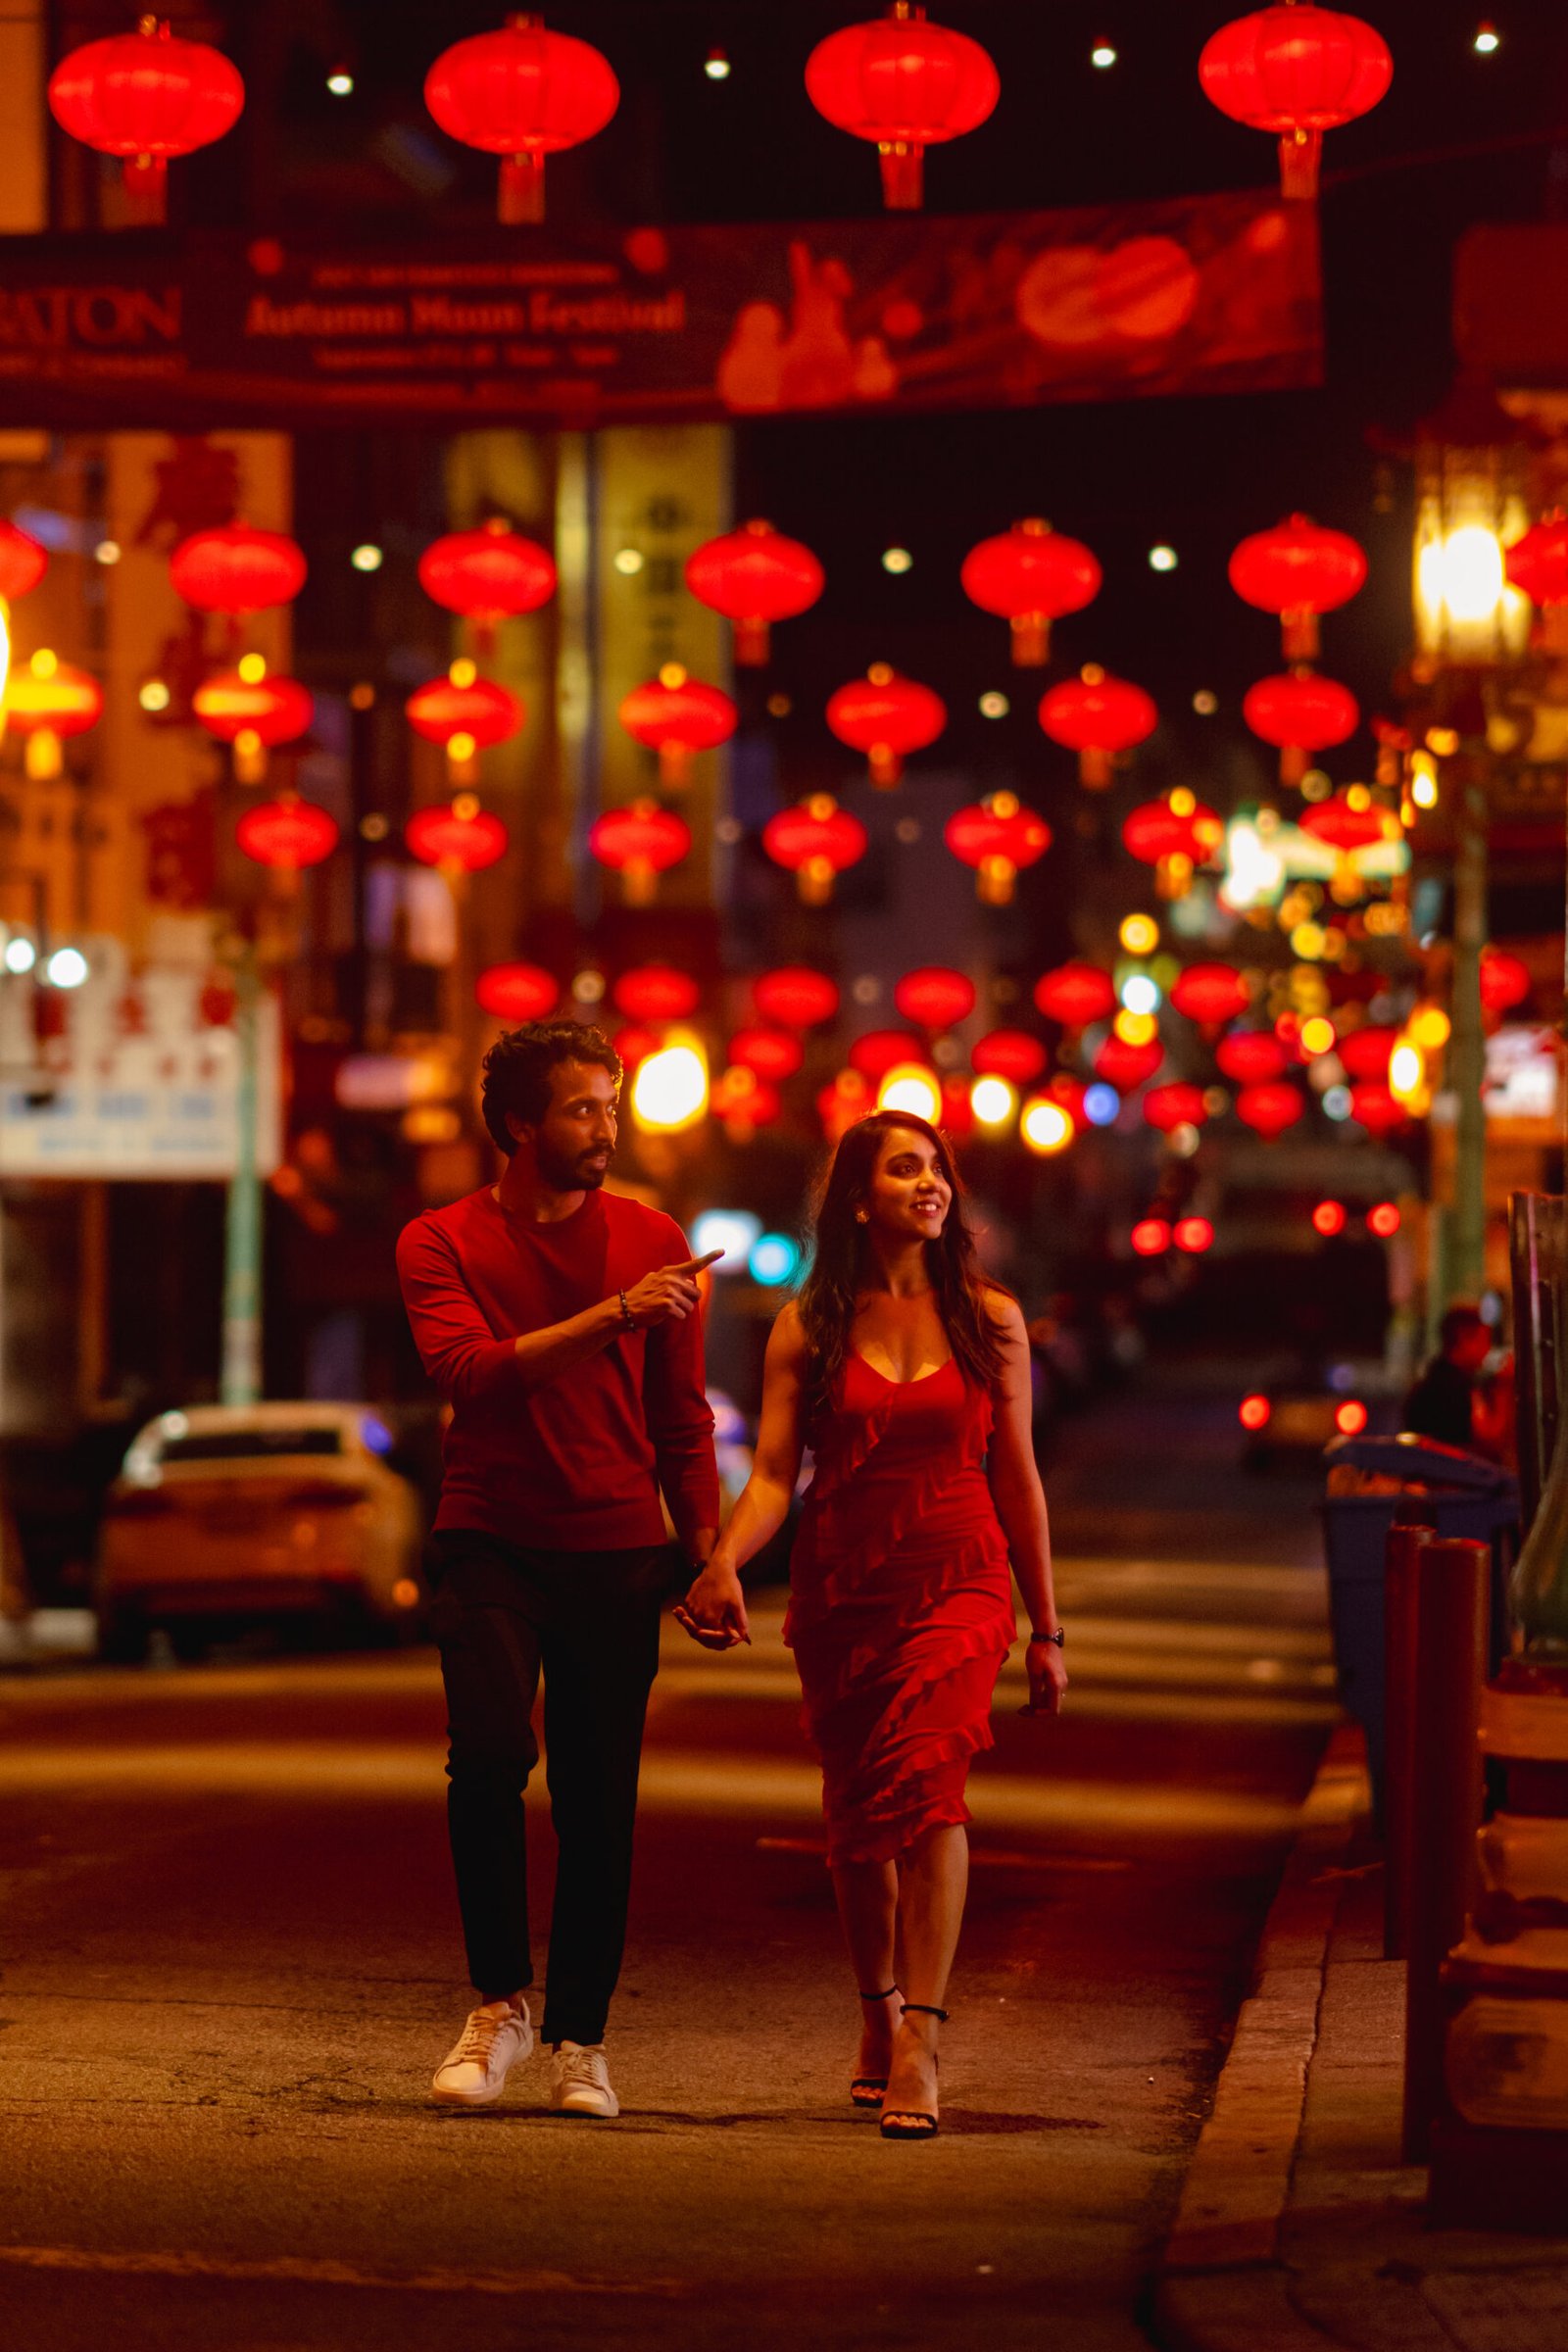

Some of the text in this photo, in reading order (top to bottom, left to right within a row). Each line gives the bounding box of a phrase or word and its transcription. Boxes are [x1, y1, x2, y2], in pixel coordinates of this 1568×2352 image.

[0, 287, 181, 346] ATON
[245, 291, 685, 336] Autumn Moon Festival
